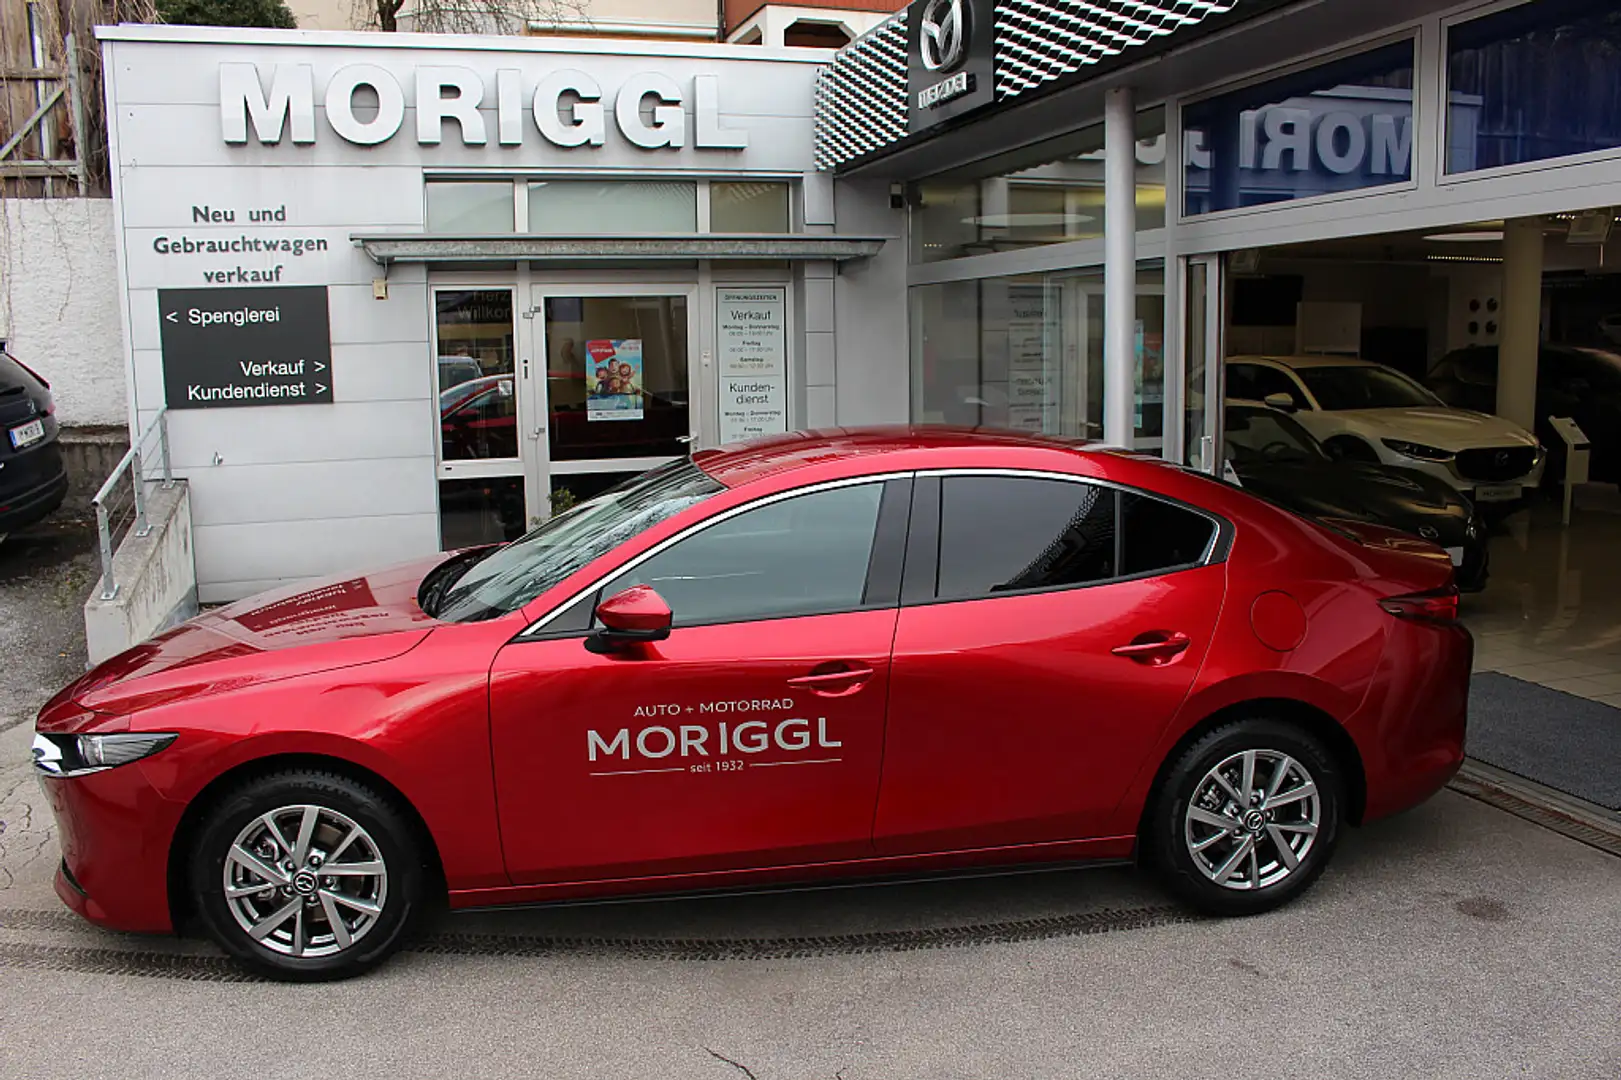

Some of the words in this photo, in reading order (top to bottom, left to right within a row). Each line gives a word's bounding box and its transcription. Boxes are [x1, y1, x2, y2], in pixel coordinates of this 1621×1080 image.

[219, 61, 749, 150] MORIGGL
[192, 205, 235, 222] Neu
[249, 205, 287, 222] und
[153, 236, 328, 256] Gebrauchtwagen
[203, 265, 283, 283] verkauf
[188, 306, 281, 327] Spenglerei
[730, 310, 772, 321] Verkauf
[240, 359, 305, 377] Verkauf
[188, 382, 306, 401] Kundendienst
[729, 383, 775, 393] Kunden-
[735, 394, 769, 405] dienst
[633, 703, 681, 717] AUTO
[699, 698, 794, 714] MOTORRAD
[587, 717, 842, 762] MORIGGL
[690, 762, 711, 773] seit
[716, 760, 744, 772] 1932
